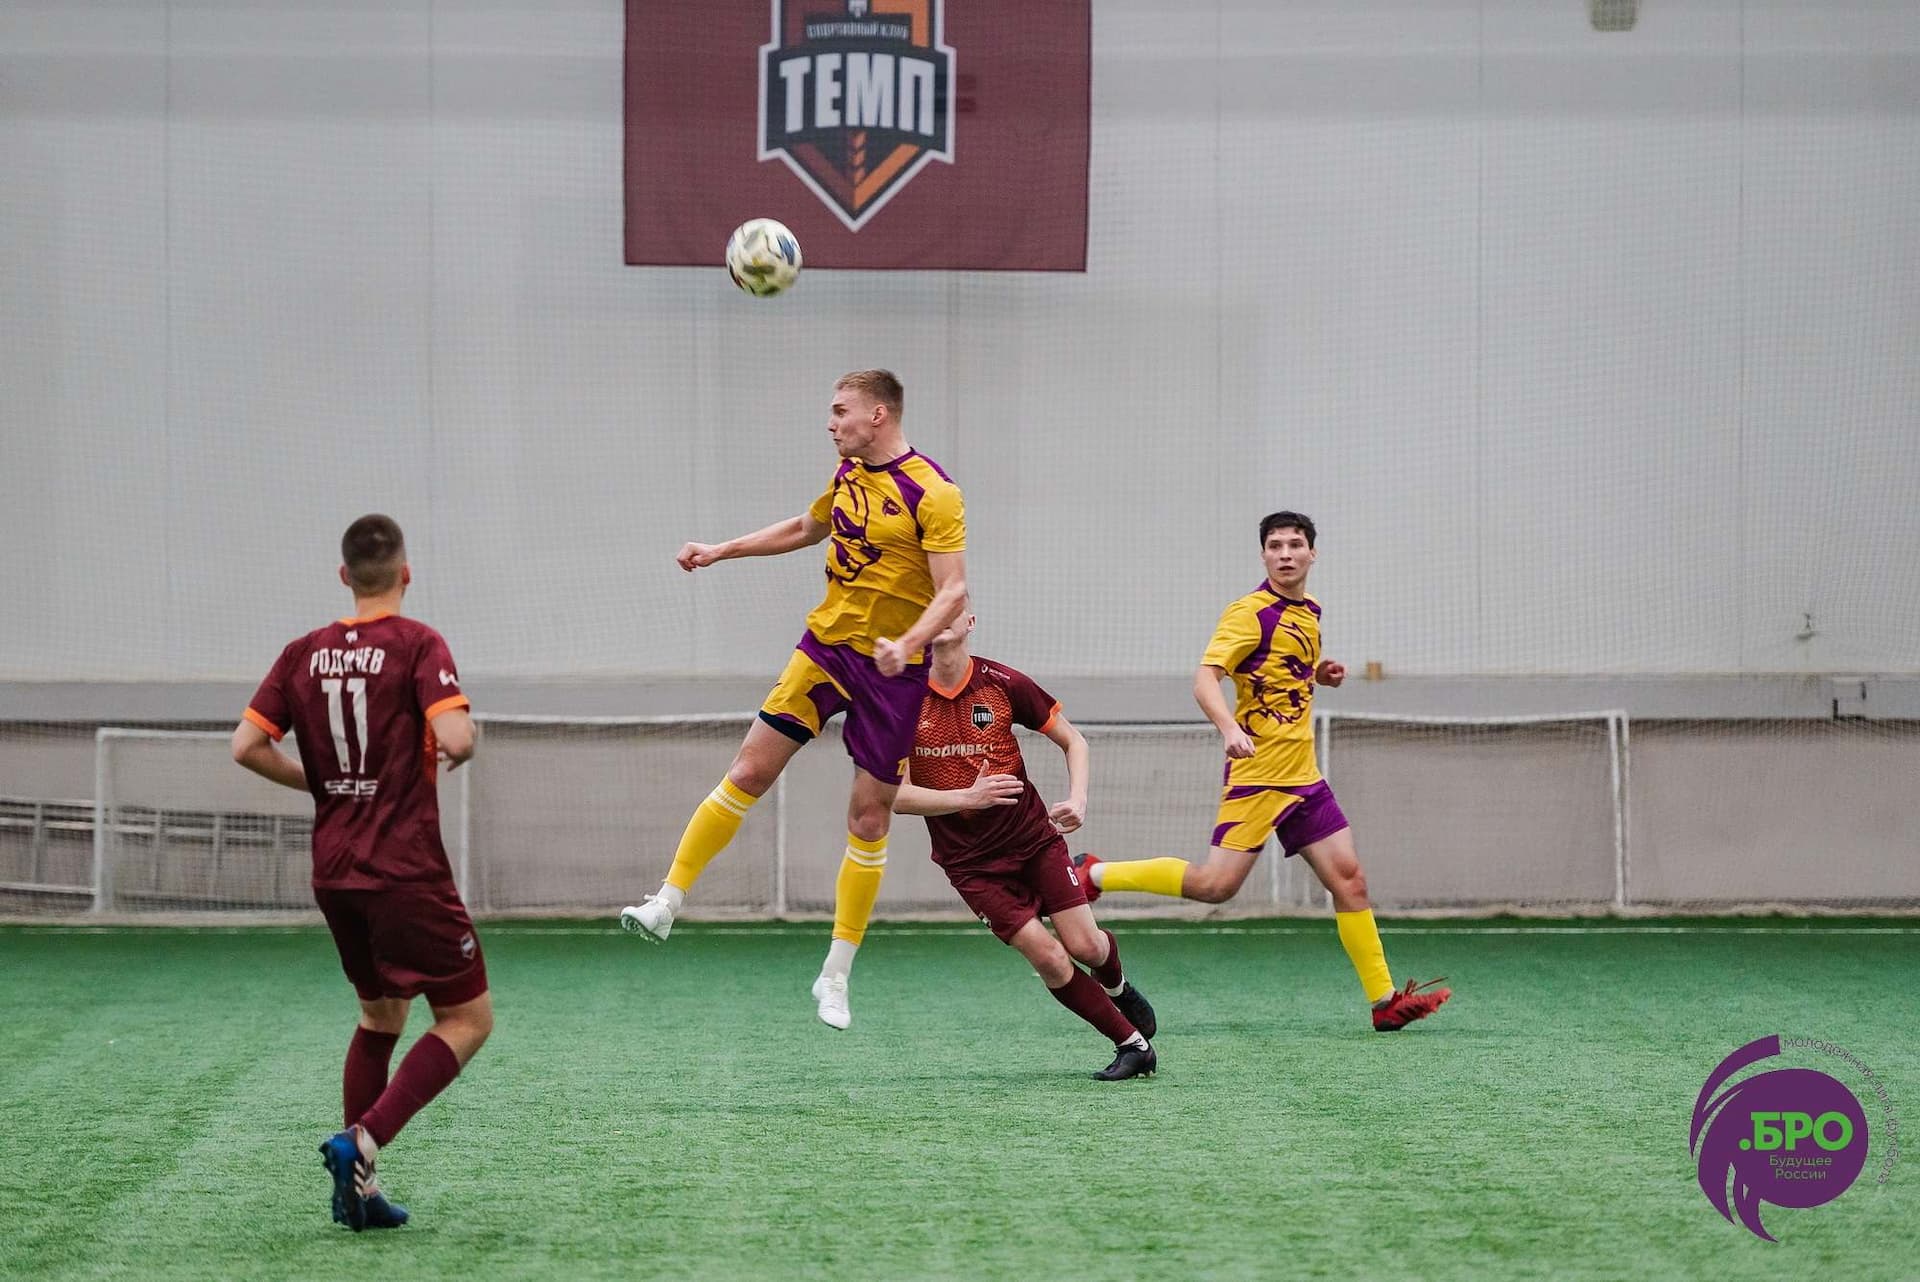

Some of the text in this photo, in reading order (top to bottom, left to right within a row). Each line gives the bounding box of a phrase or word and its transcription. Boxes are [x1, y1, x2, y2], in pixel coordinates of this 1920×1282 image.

[779, 52, 936, 136] ТЕМП
[321, 678, 367, 774] 11
[973, 712, 993, 724] ТЕМП
[915, 743, 994, 758] ПРОДИНВЕС
[1066, 867, 1078, 886] 6
